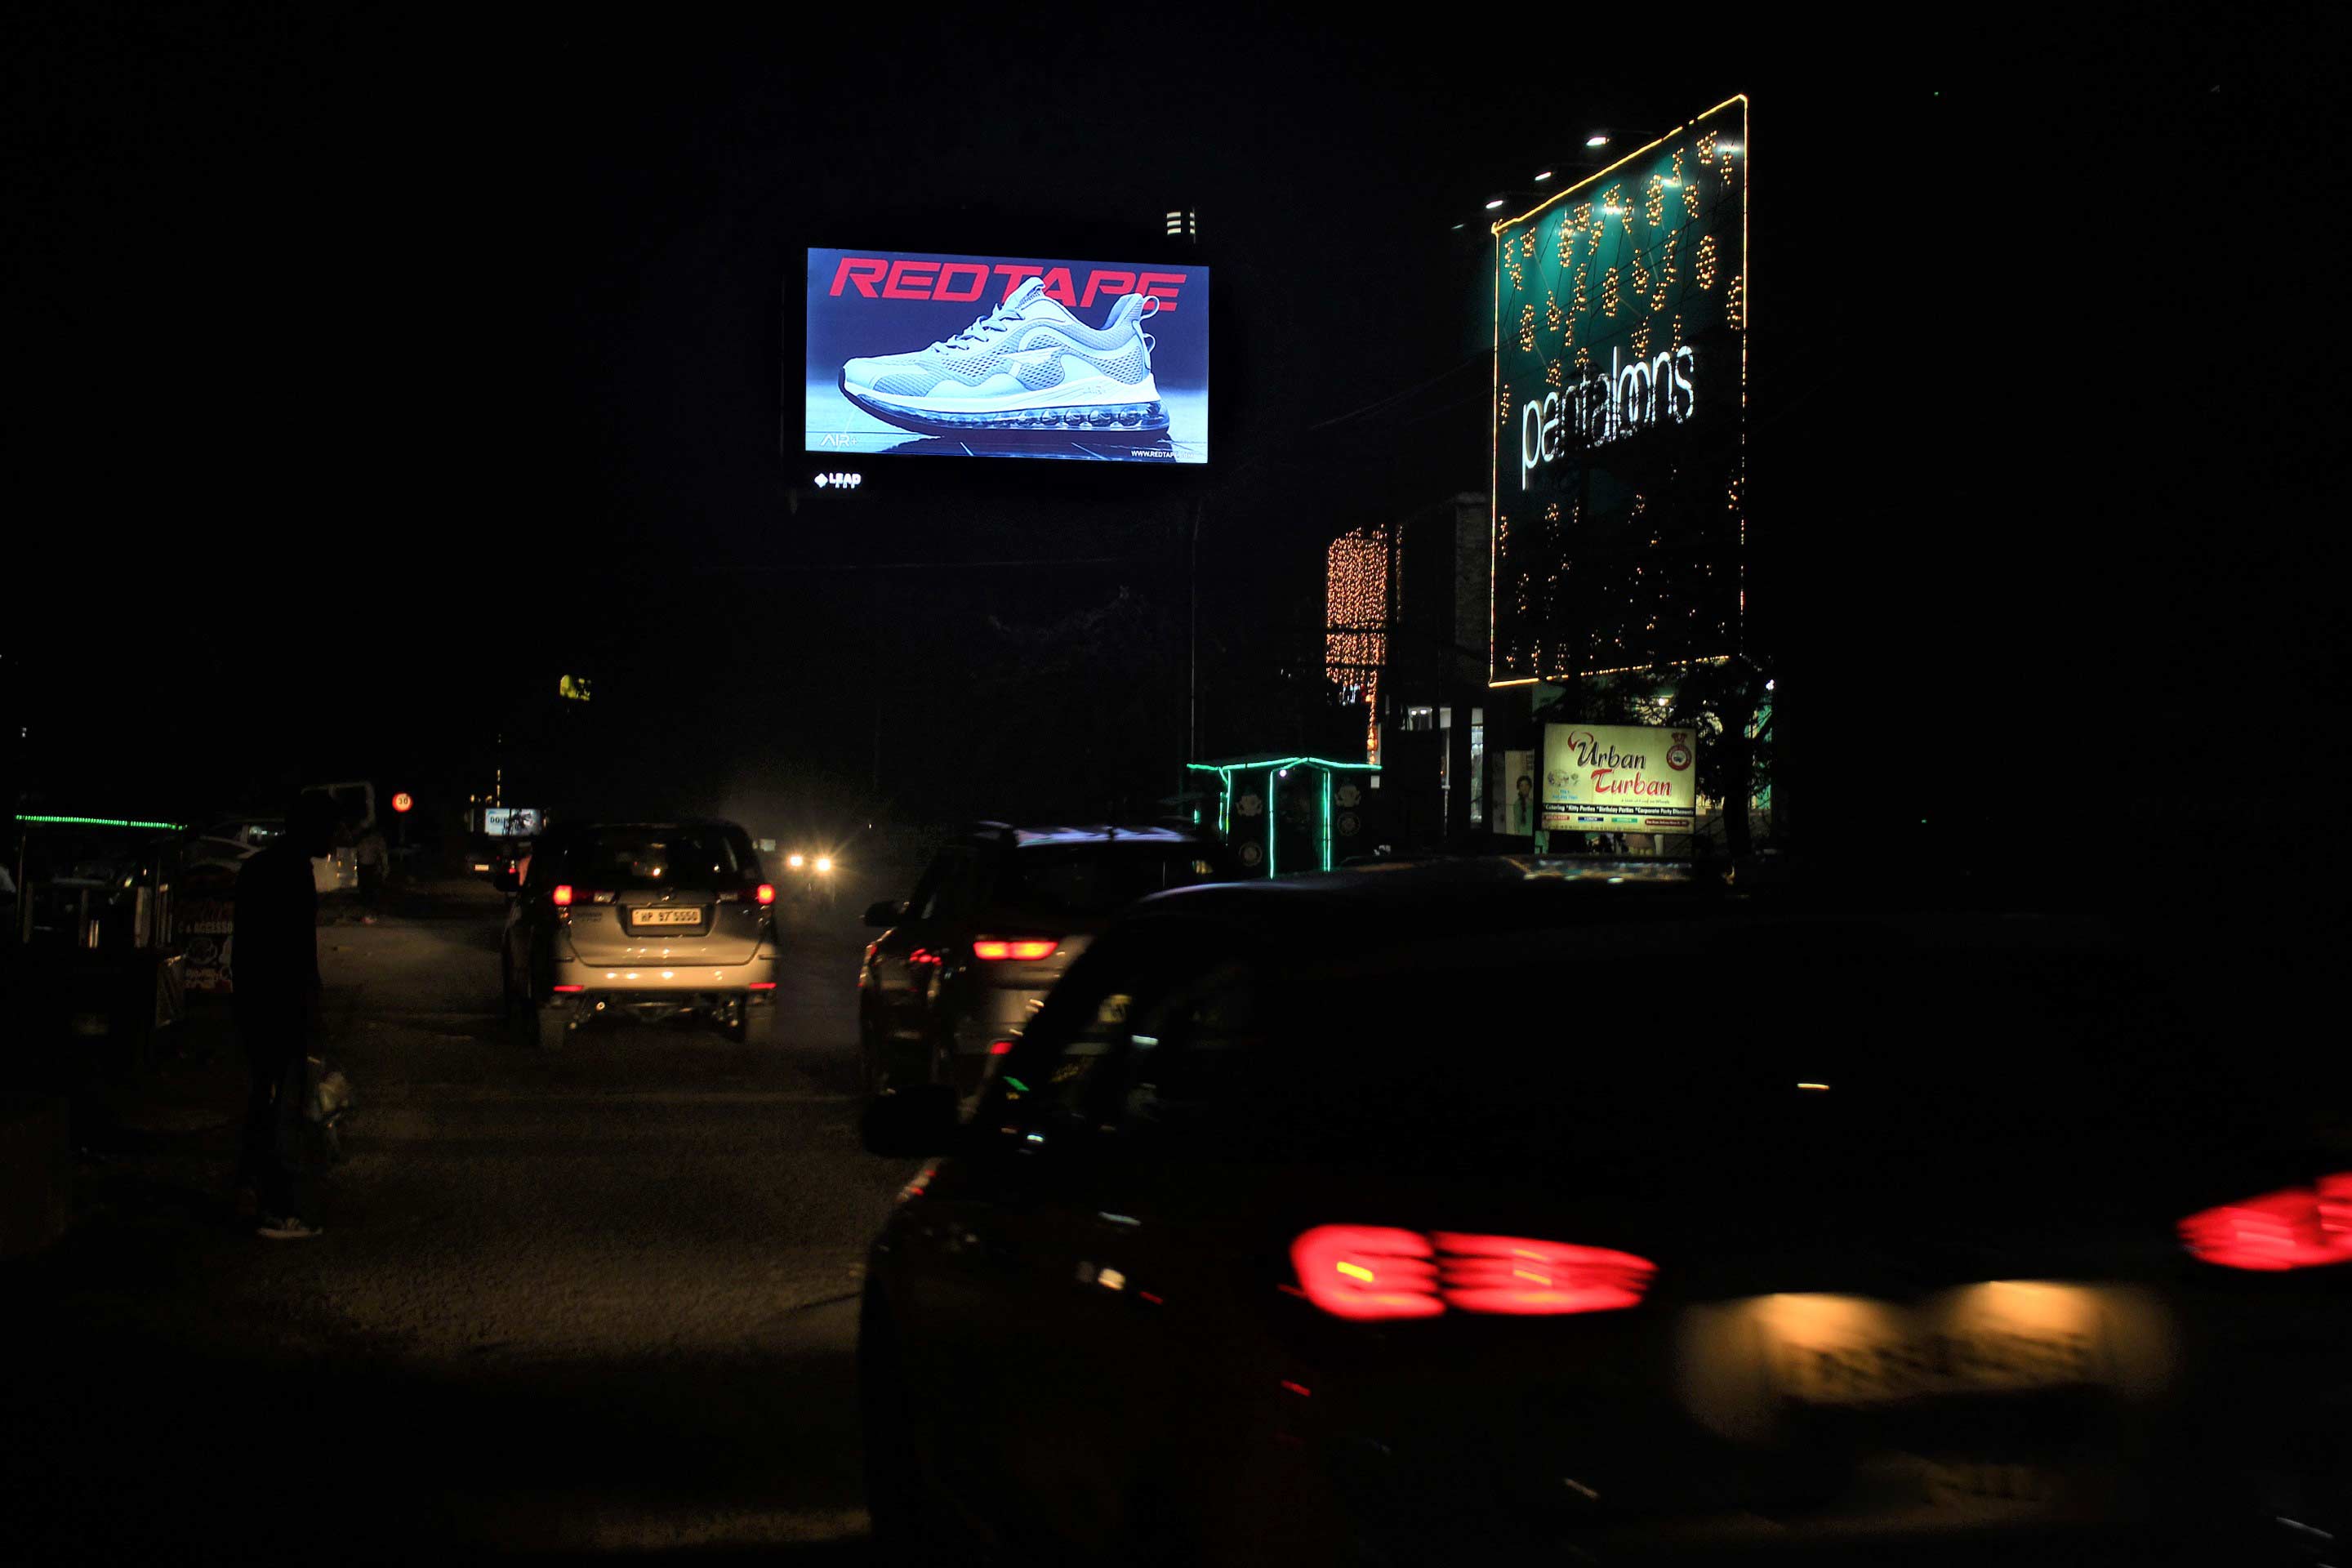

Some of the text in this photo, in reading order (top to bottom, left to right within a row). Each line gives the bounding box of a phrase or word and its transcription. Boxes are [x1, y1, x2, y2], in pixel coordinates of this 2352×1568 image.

[829, 257, 1187, 312] REDTAPE
[1521, 345, 1694, 491] pantaloons
[1575, 741, 1646, 768] Urban
[1590, 768, 1672, 796] Turban
